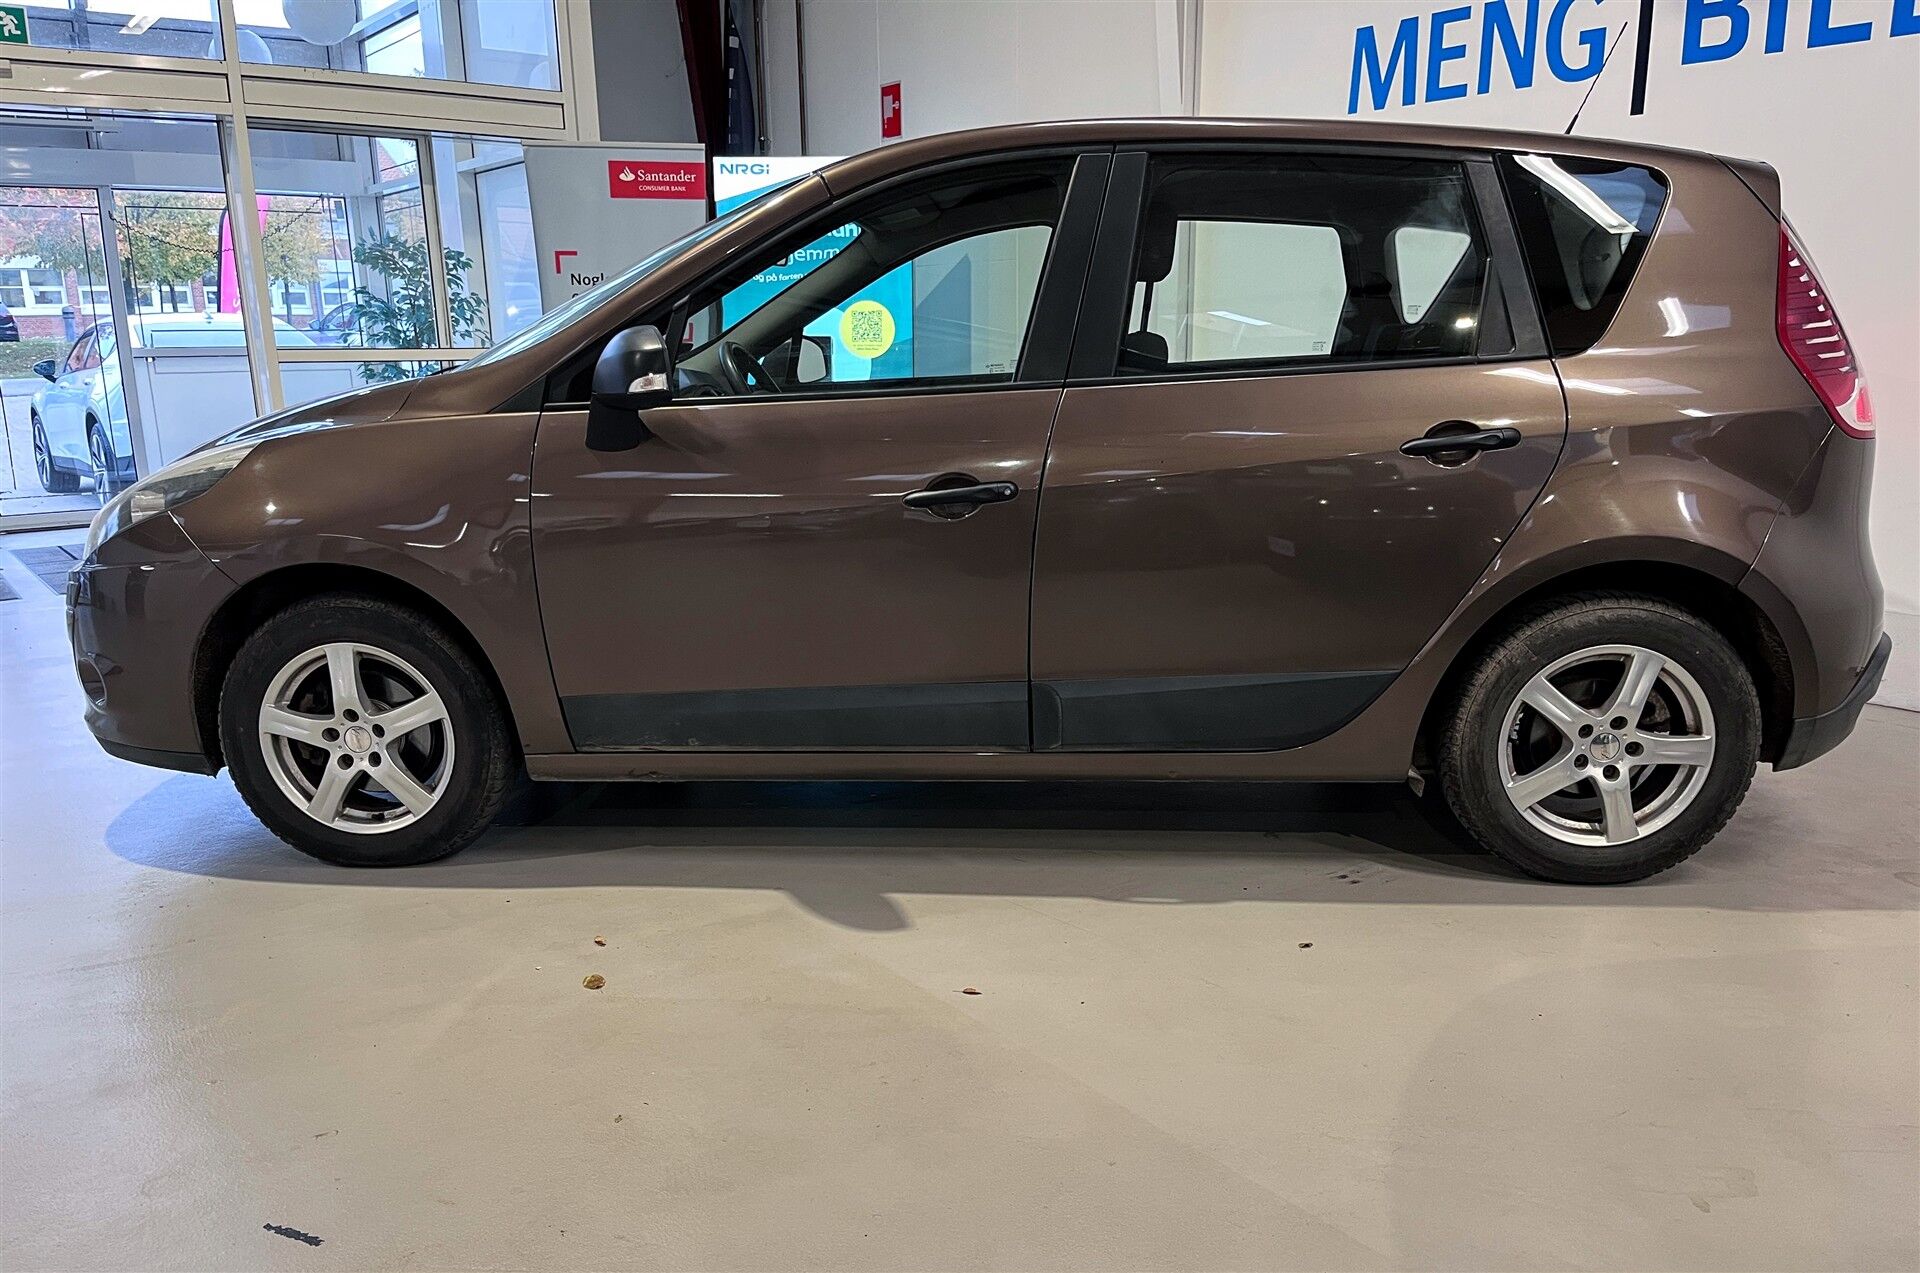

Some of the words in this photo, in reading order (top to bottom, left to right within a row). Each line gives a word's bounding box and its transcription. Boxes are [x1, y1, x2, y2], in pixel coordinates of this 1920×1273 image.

[1347, 0, 1607, 115] MENG
[1681, 0, 1920, 66] BIL
[637, 169, 696, 183] Santander
[719, 163, 770, 175] NRGi
[570, 272, 605, 287] Nogl
[765, 272, 778, 284] på
